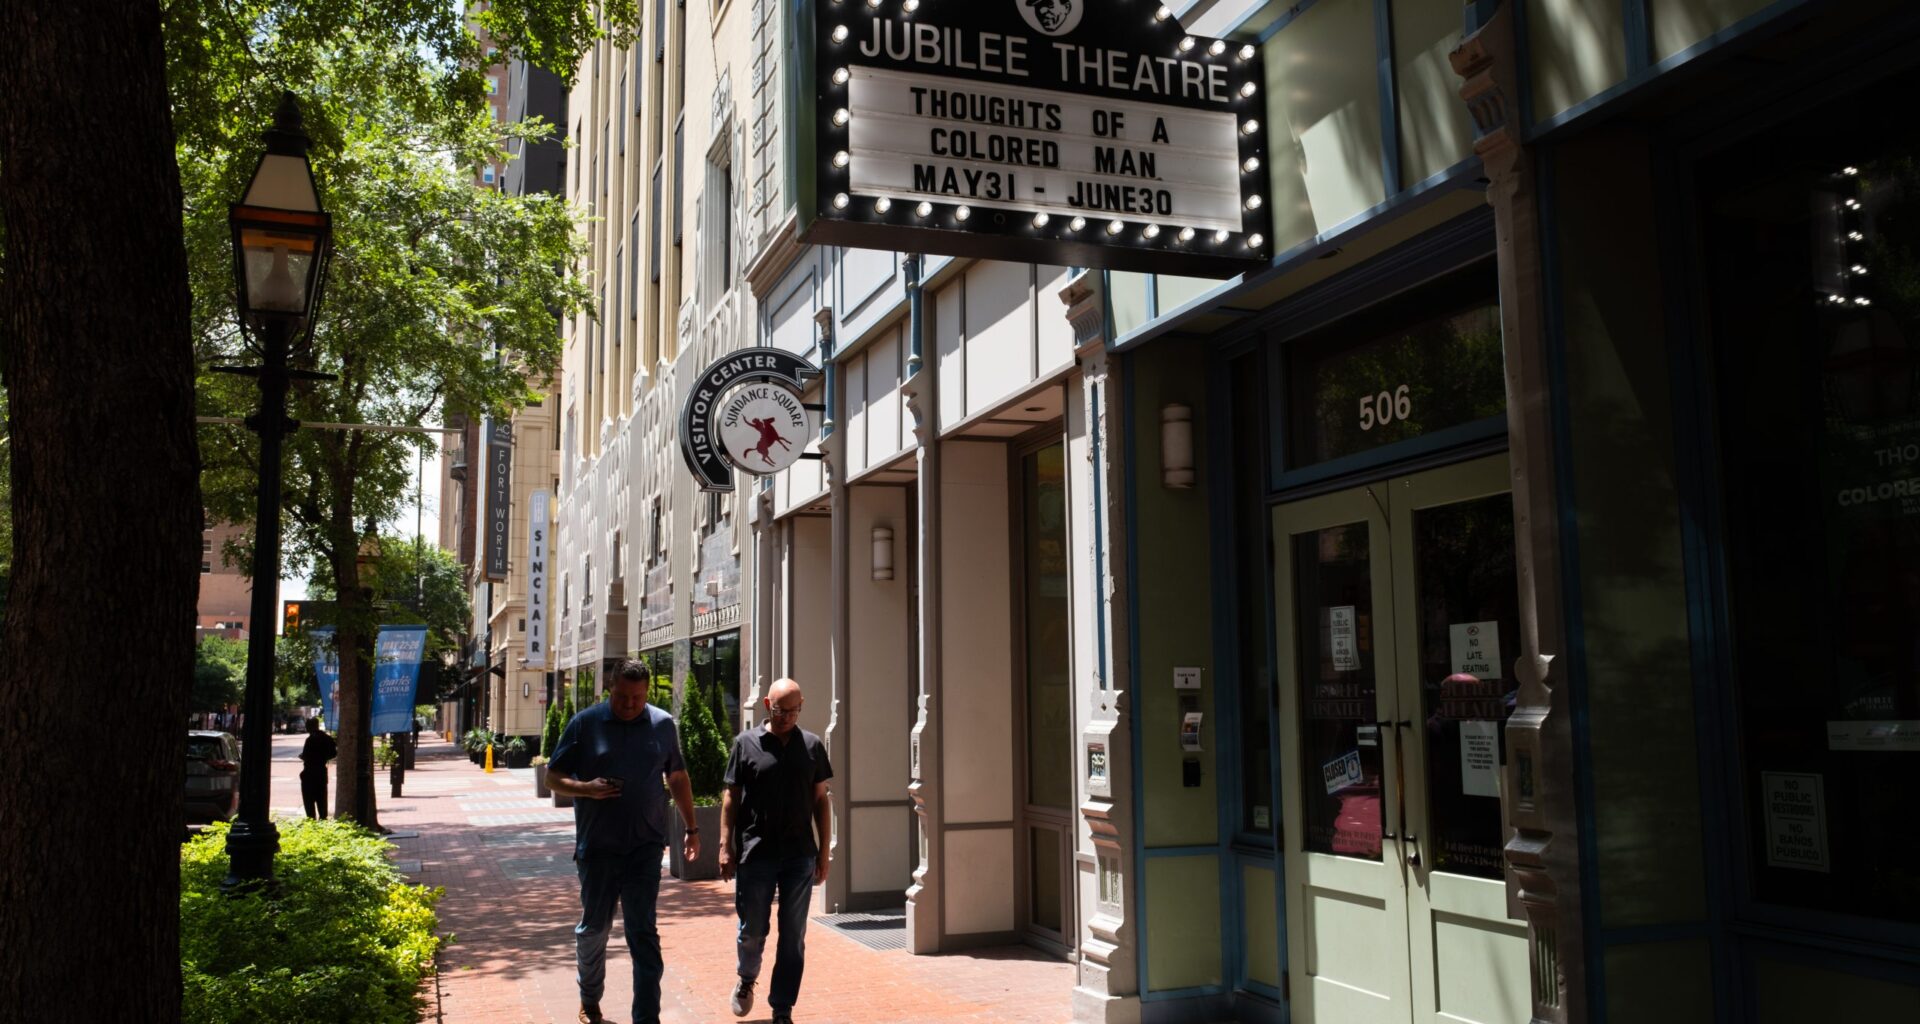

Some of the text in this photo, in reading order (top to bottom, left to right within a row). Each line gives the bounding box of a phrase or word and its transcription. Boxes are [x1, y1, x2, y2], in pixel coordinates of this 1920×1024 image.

[859, 17, 1229, 102] JUBILEE THEATRE
[910, 87, 1169, 144] THOUGHTS OF A
[931, 128, 1156, 178] COLORED MAN
[914, 164, 1015, 200] MAY31
[1067, 181, 1172, 216] JUNE30
[692, 356, 777, 464] VISITOR CENTER
[725, 388, 804, 428] SUNDANCE SQUARE
[1360, 385, 1411, 430] 506
[497, 450, 507, 502] FORT
[495, 507, 506, 570] WORTH
[531, 529, 544, 654] SINCLAIR
[1466, 651, 1483, 660] LATE
[1469, 638, 1479, 648] NO
[1461, 664, 1489, 673] SEATING
[1325, 759, 1346, 782] CLOSED
[1784, 780, 1799, 790] NO
[1774, 791, 1812, 803] PUBLIC
[1789, 823, 1804, 834] NO
